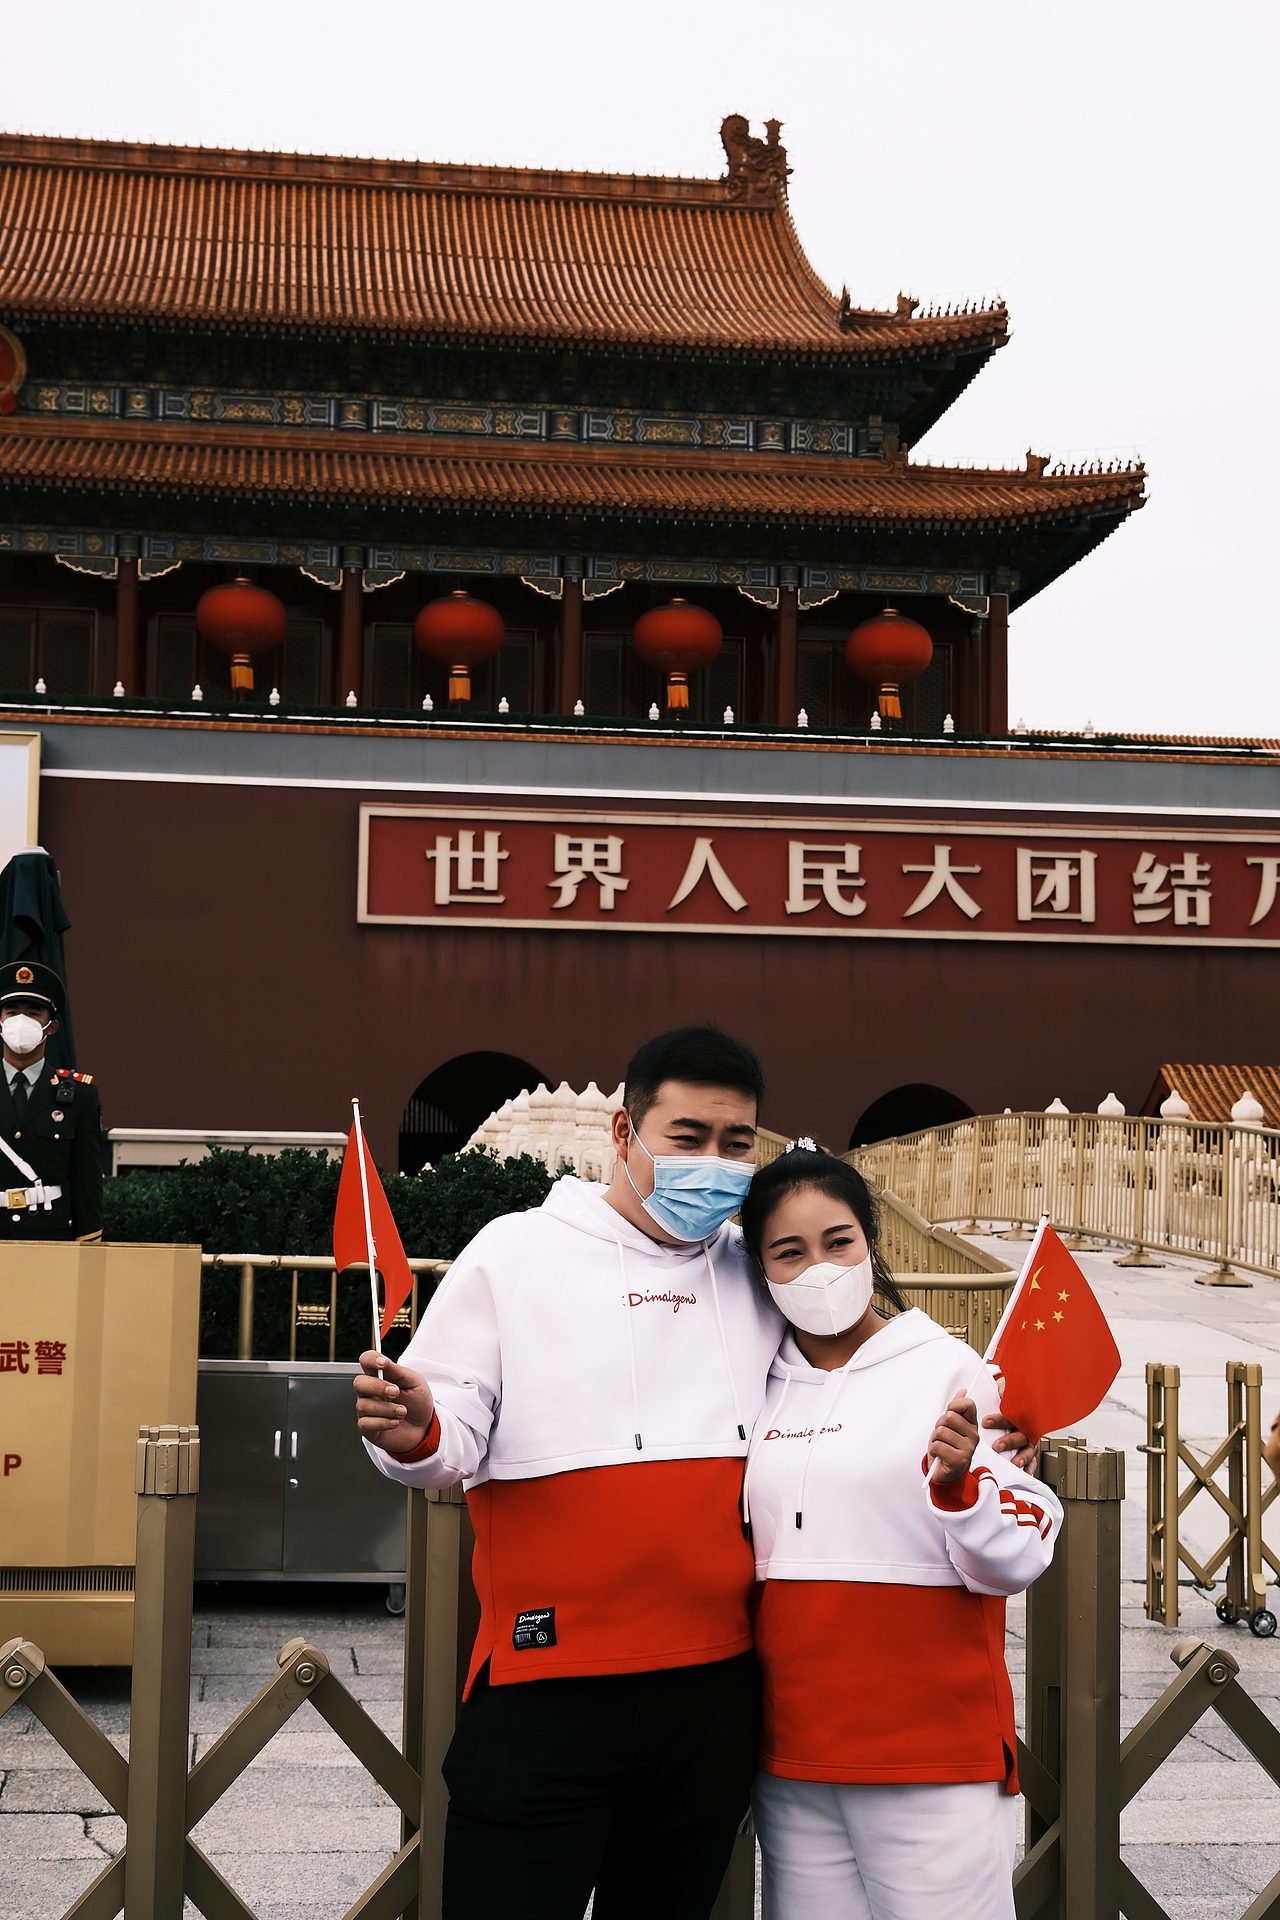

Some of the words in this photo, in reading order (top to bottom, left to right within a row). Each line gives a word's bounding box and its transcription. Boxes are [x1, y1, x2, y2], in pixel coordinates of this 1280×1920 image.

[622, 1289, 697, 1313] Dimalegend
[0, 1340, 67, 1375] 武警
[763, 1423, 843, 1443] Dimaleend
